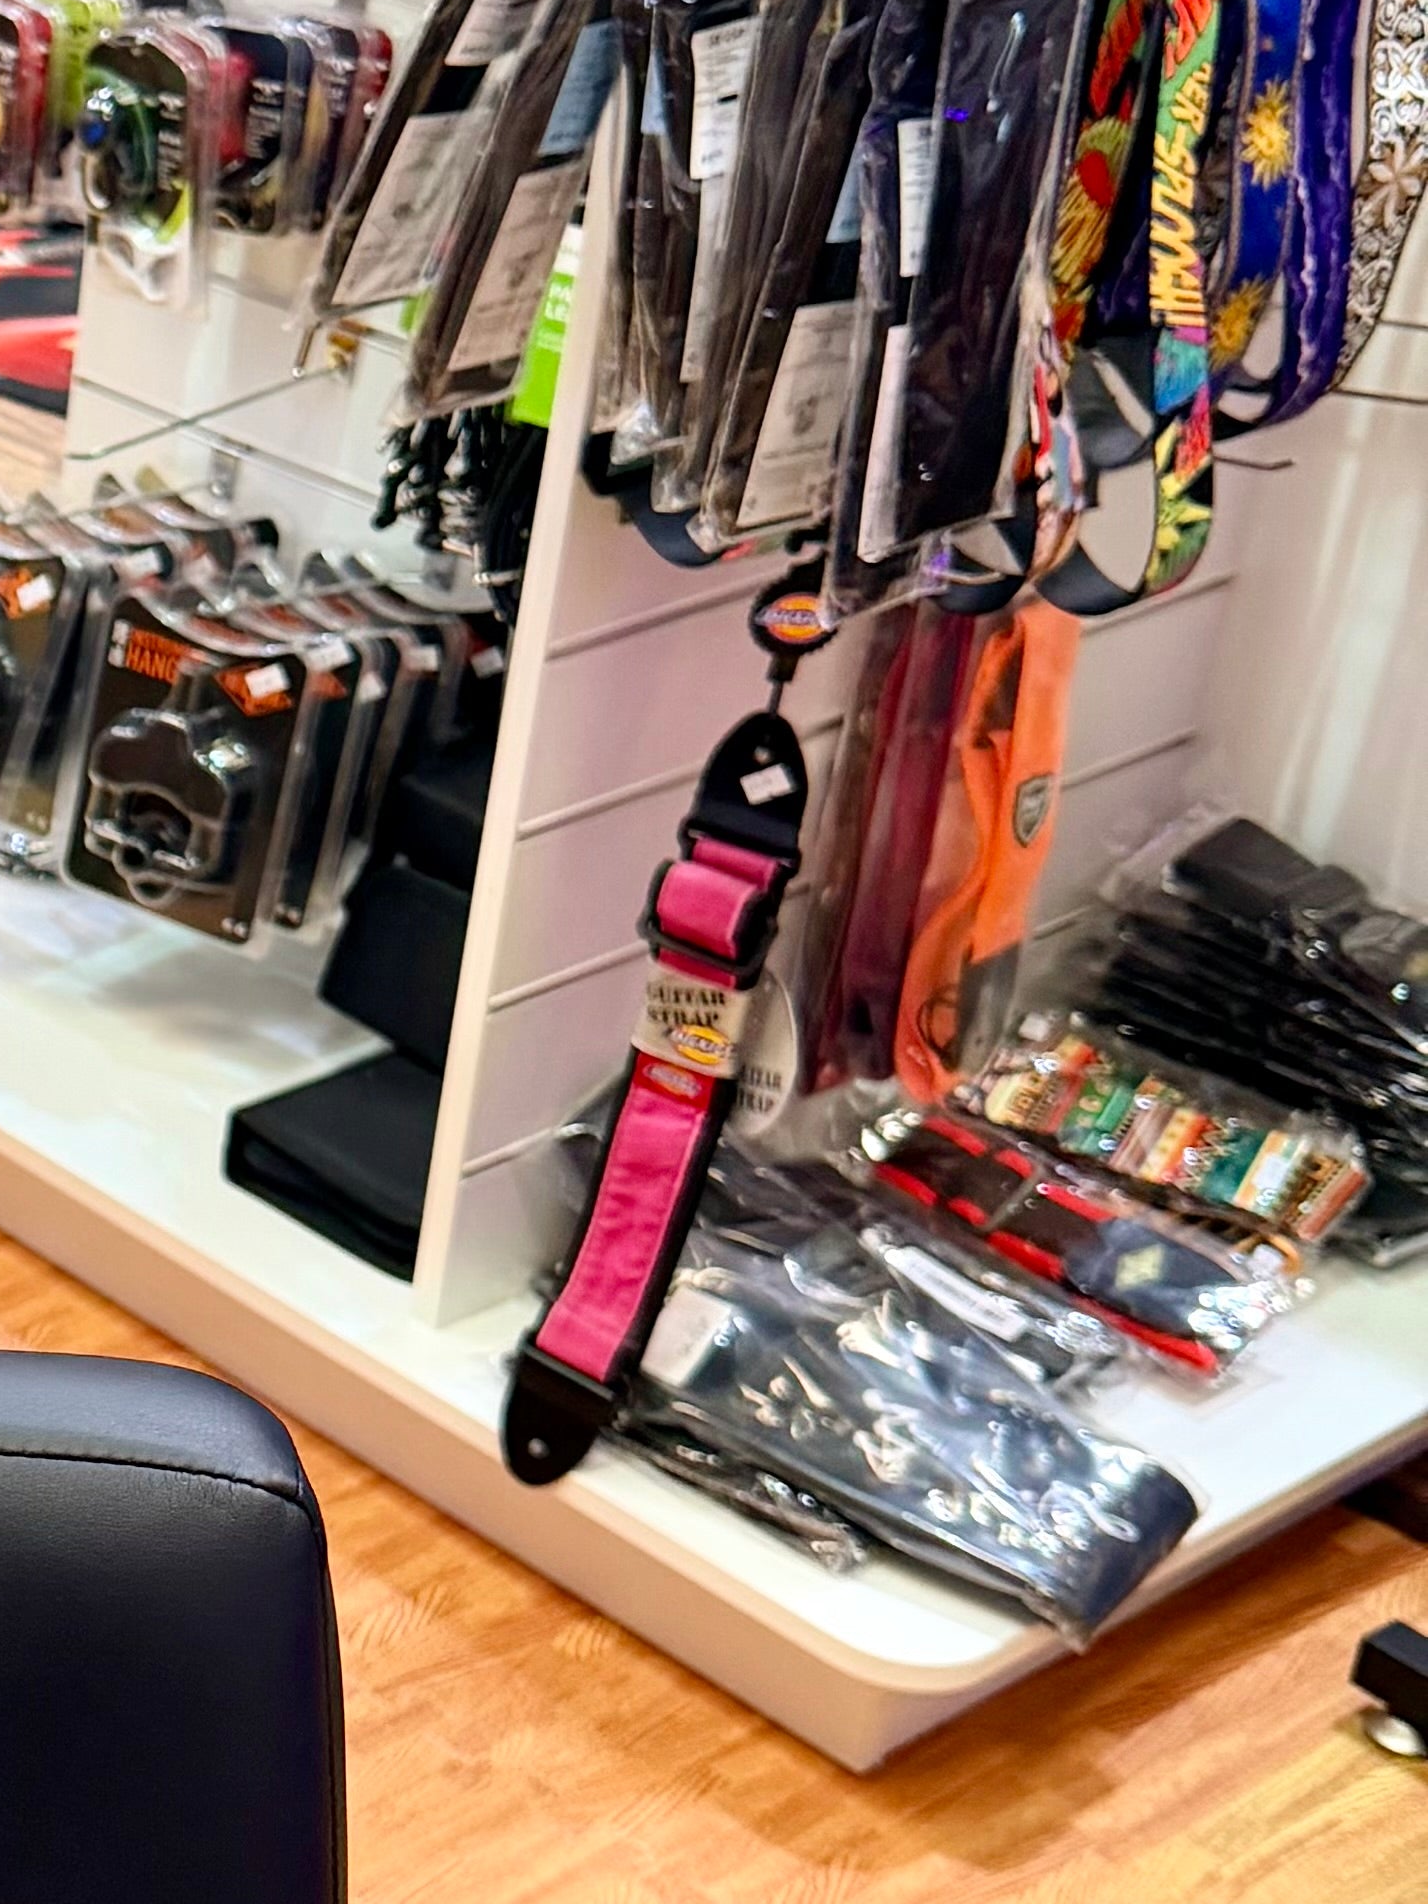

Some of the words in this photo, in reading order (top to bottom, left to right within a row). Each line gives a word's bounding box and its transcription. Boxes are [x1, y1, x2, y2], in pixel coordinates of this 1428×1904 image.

[126, 644, 179, 684] HANG
[646, 982, 726, 1007] GUITAR
[647, 1007, 720, 1028] STRAP
